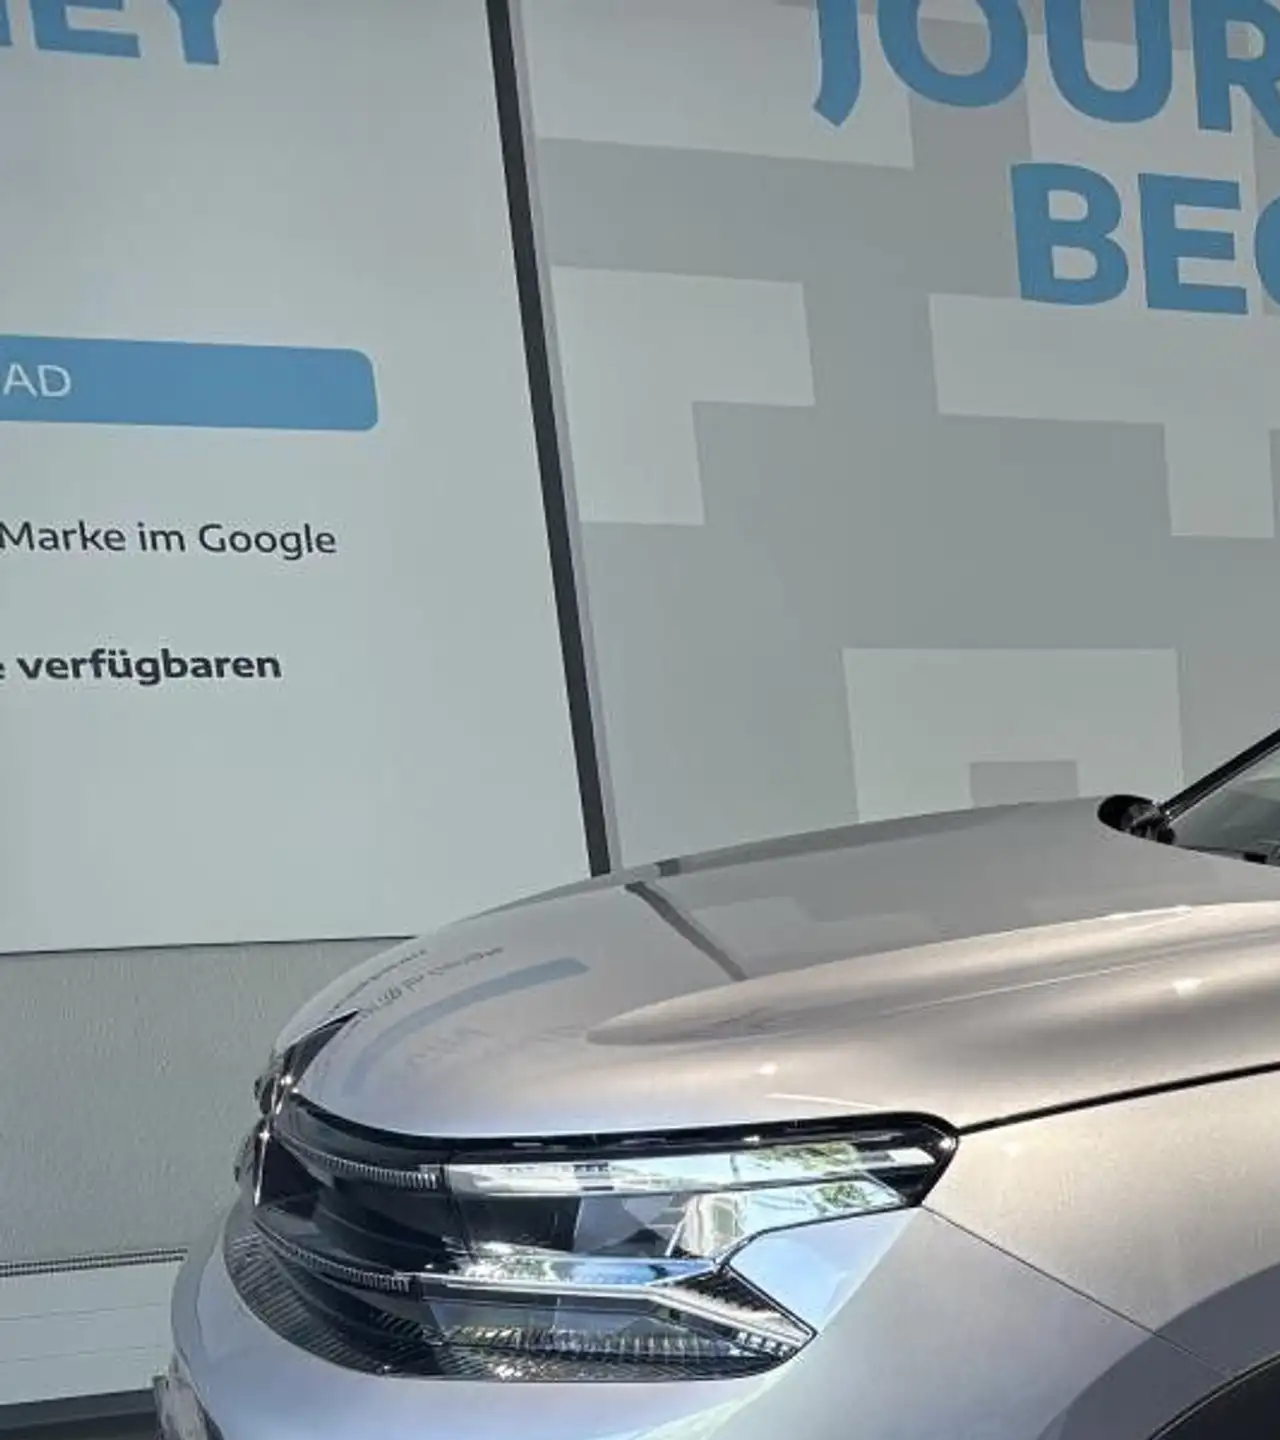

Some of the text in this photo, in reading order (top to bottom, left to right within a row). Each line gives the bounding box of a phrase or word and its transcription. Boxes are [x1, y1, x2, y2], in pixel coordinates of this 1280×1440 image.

[0, 520, 336, 561] Marke im Google
[16, 648, 282, 686] verfügbaren
